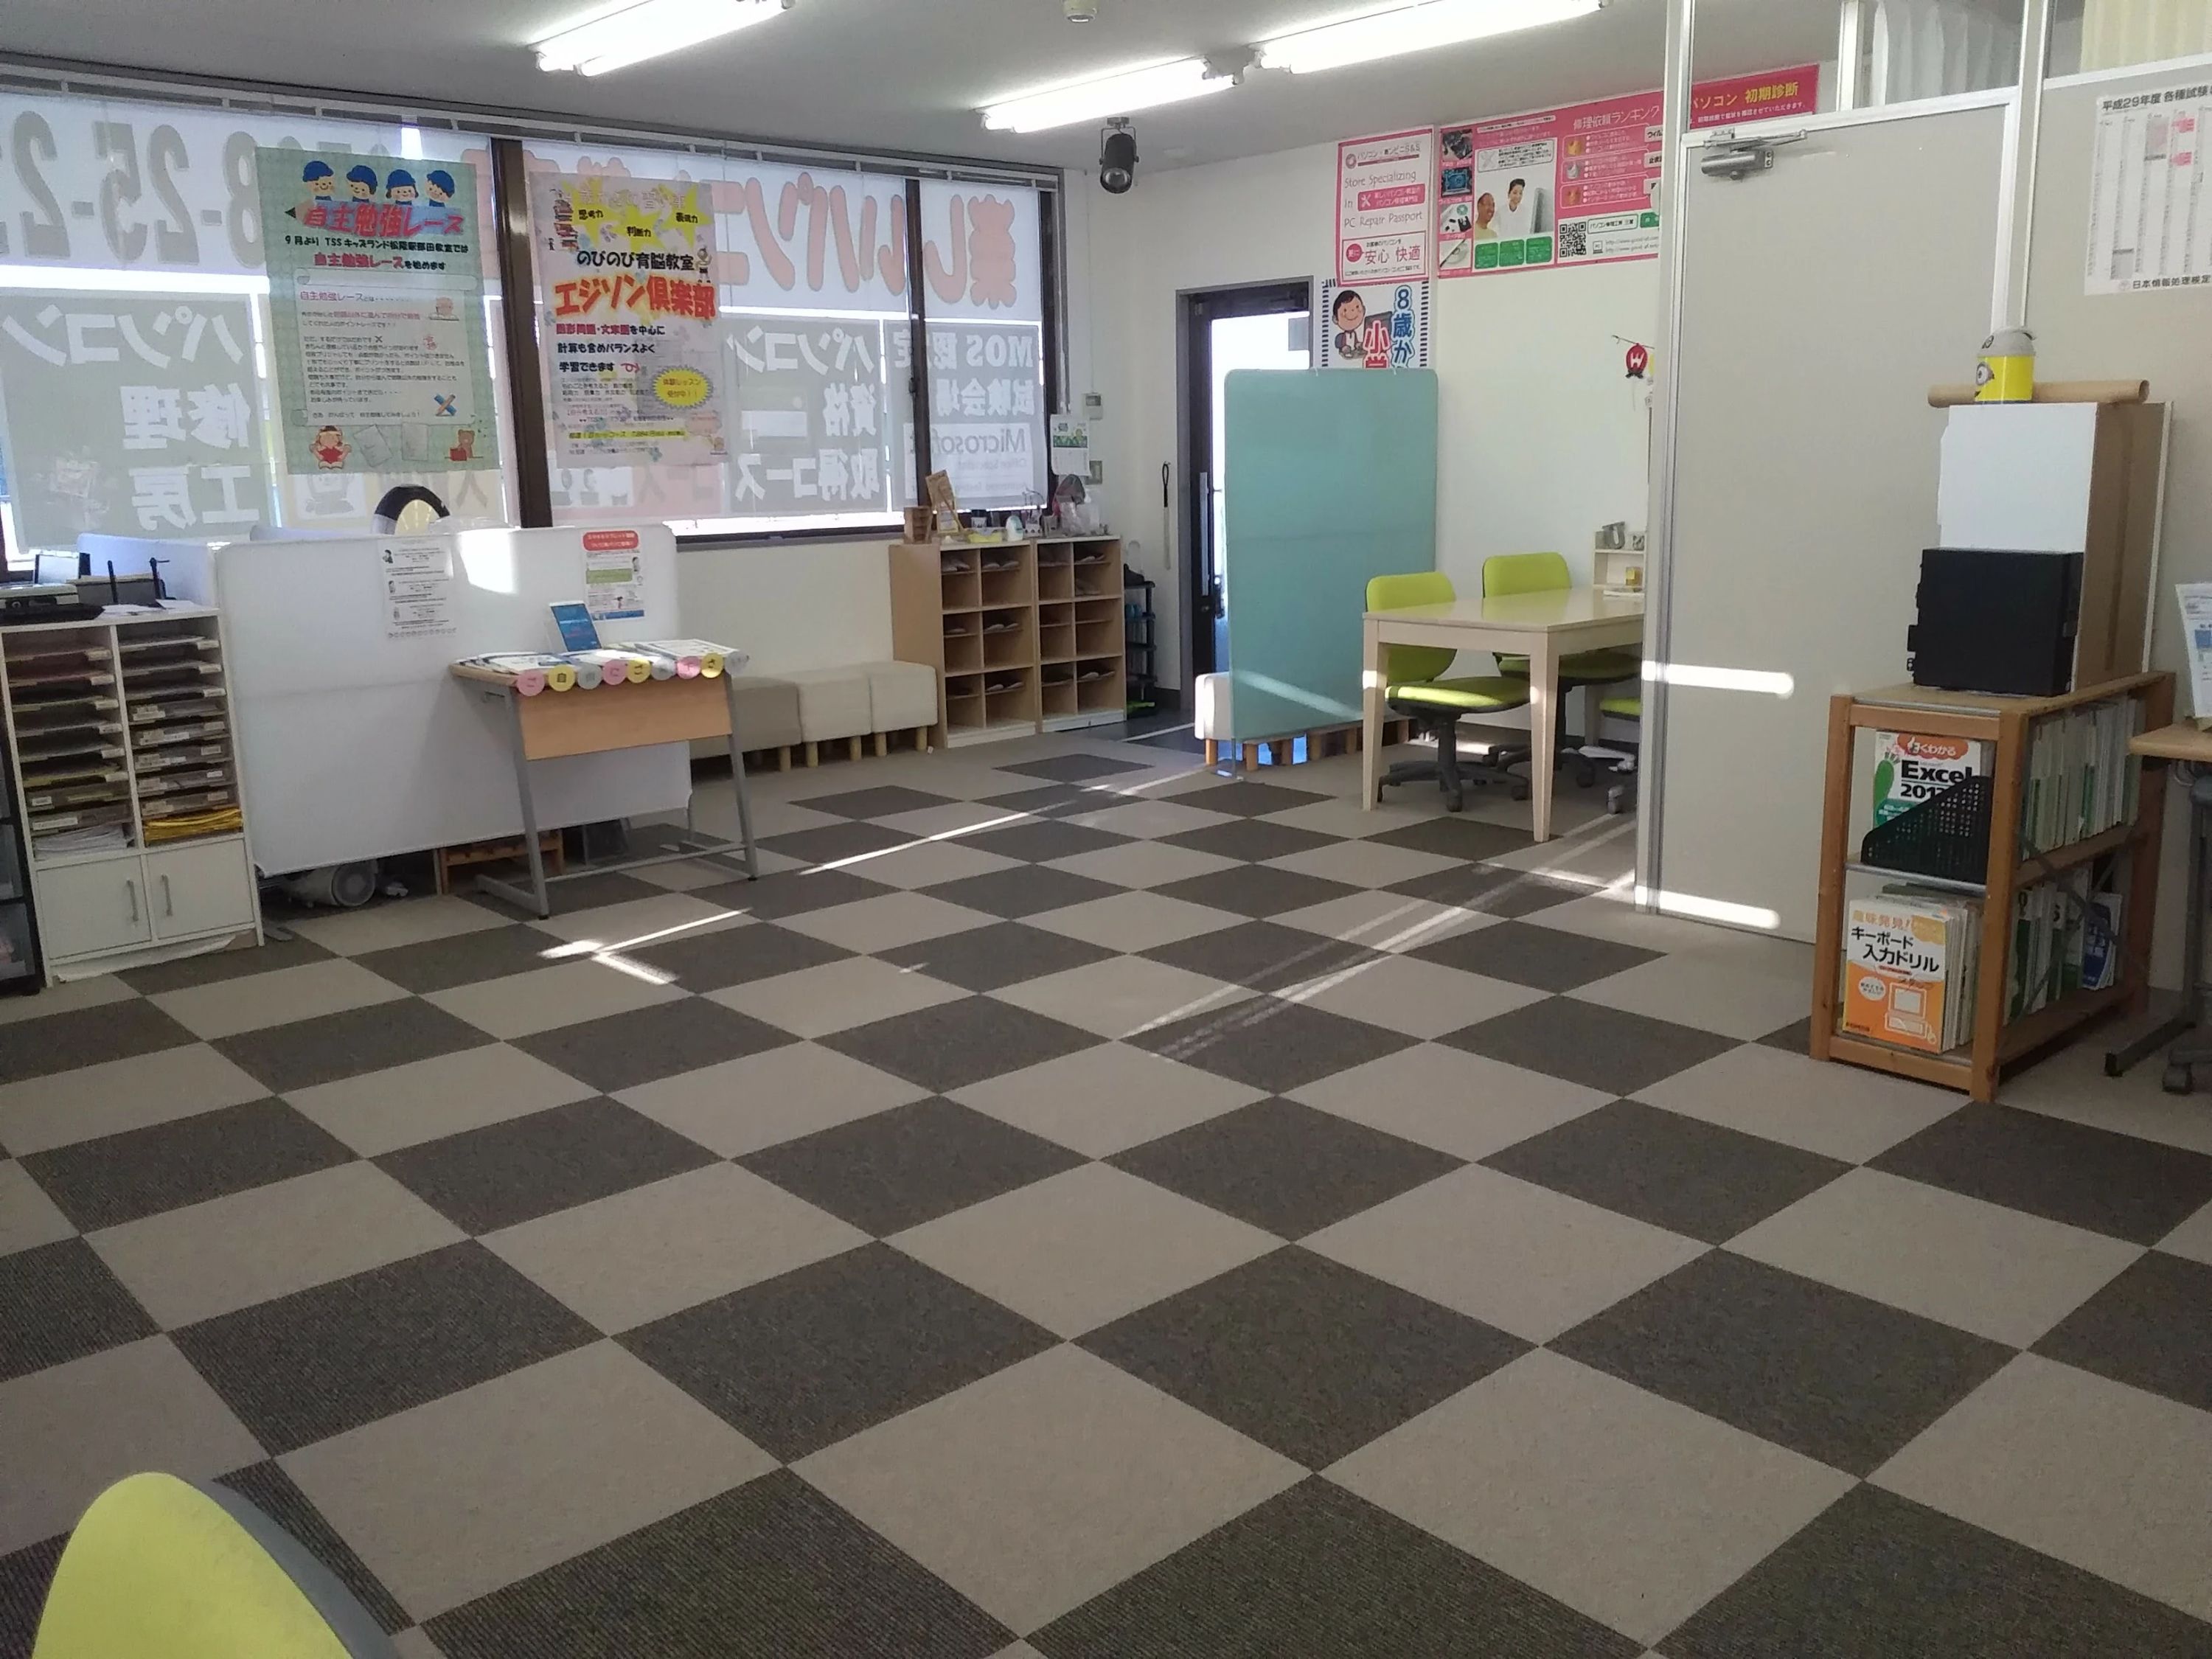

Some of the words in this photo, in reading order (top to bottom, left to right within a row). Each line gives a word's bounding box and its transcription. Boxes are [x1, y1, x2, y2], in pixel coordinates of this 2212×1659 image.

[1745, 82, 1799, 104] 初期診断
[2102, 93, 2161, 111] 平成29年度
[1573, 105, 1660, 131] 修理依頼ランキング
[1344, 177, 1366, 189] Store
[1369, 170, 1416, 185] Specializing
[304, 201, 465, 238] 自主勉強レース
[578, 209, 604, 220] 思考力
[675, 212, 699, 224] 表現力
[1344, 217, 1356, 229] PC
[1360, 215, 1385, 229] Repair
[1389, 211, 1422, 225] Passport
[627, 226, 652, 237] 判断力
[314, 251, 446, 271] 自主勉強レースを始めます
[577, 250, 695, 271] のびのび育脳教室
[1365, 249, 1390, 265] 安心
[1396, 245, 1421, 262] 快適
[554, 274, 717, 321] エジソン倶楽部
[1391, 287, 1413, 368] 8歳か
[557, 343, 655, 354] 計算も含めバランスよく
[559, 361, 616, 373] 学習できます
[663, 377, 702, 386] 体験レッスン
[1907, 737, 1956, 757] よくわかる
[1901, 759, 1973, 784] Excel
[1851, 926, 1914, 950] キーボード
[1863, 943, 1940, 973] 入力ドリル
